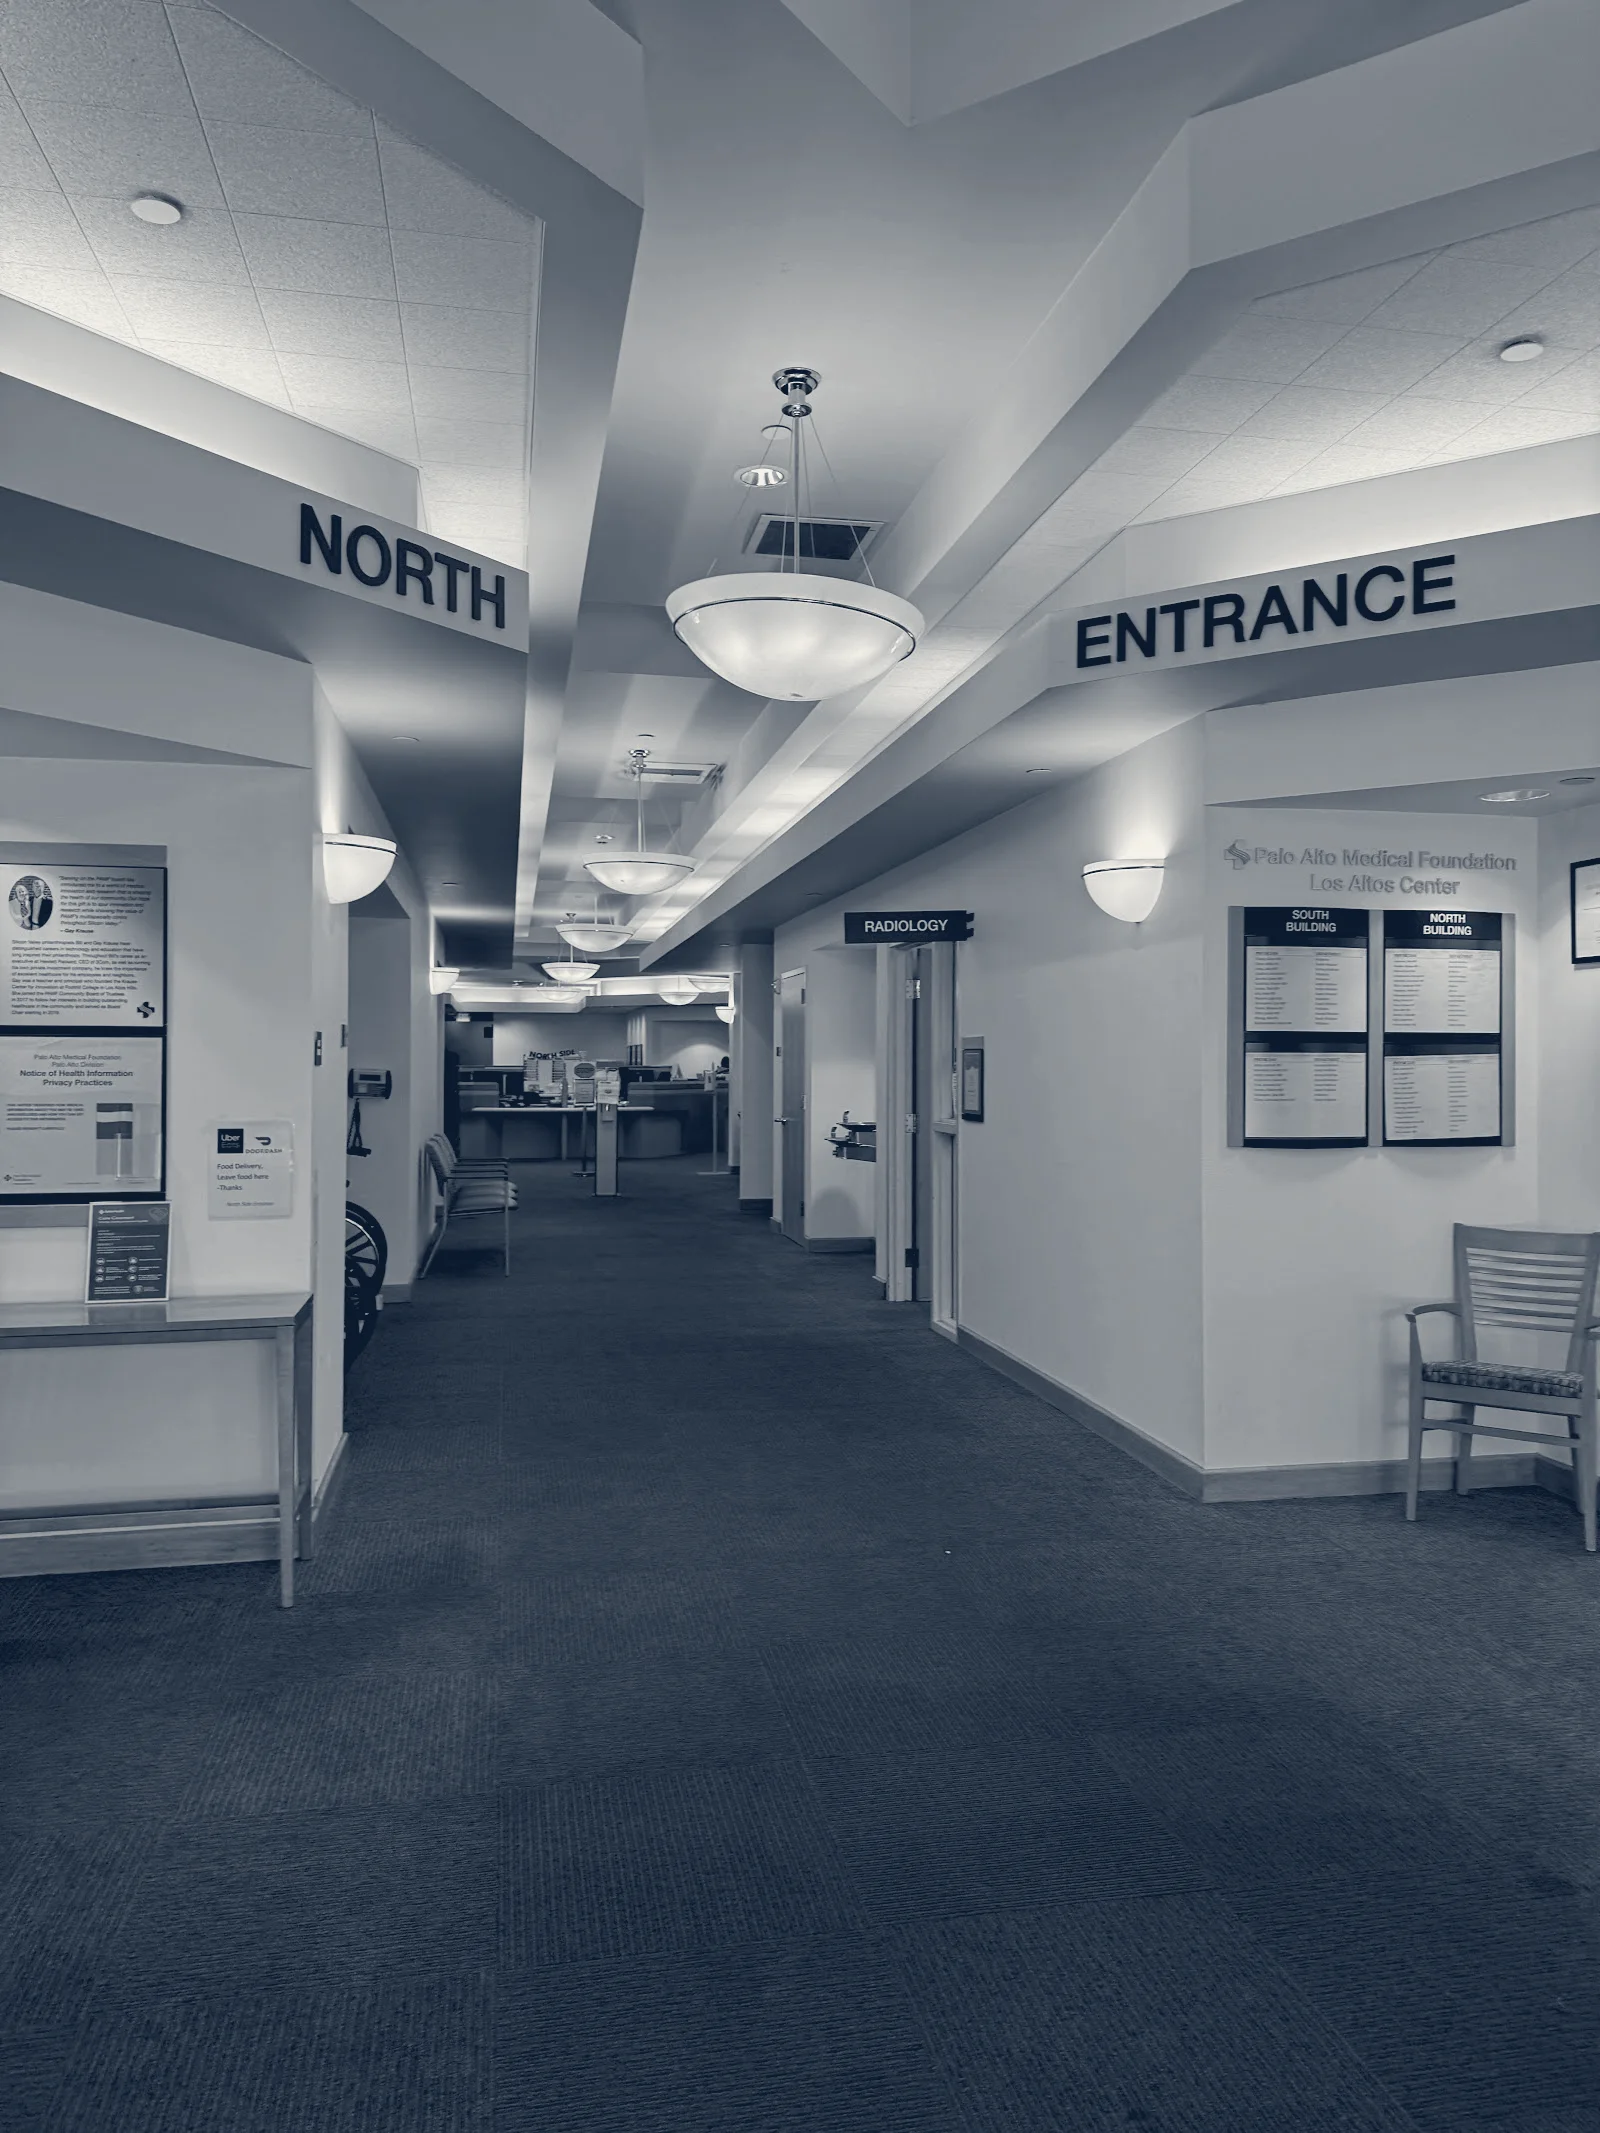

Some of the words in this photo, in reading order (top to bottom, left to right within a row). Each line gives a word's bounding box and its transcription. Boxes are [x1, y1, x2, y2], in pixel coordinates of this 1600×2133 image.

[300, 502, 505, 629] NORTH
[1077, 554, 1456, 669] ENTRANCE
[1254, 848, 1294, 865] Palo
[1300, 849, 1336, 866] Alto
[1342, 850, 1413, 868] Medical
[1418, 851, 1517, 870] Foundation
[1310, 874, 1343, 891] Los
[1348, 874, 1395, 893] Altos
[1400, 875, 1460, 895] Center
[1292, 910, 1329, 920] SOUTH
[1430, 913, 1466, 924] NORTH
[864, 919, 948, 932] RADIOLOGY
[1285, 922, 1336, 932] BUILDING
[1423, 925, 1472, 936] BUILDING
[529, 1051, 557, 1060] NORTH
[43, 1079, 73, 1087] Privacy
